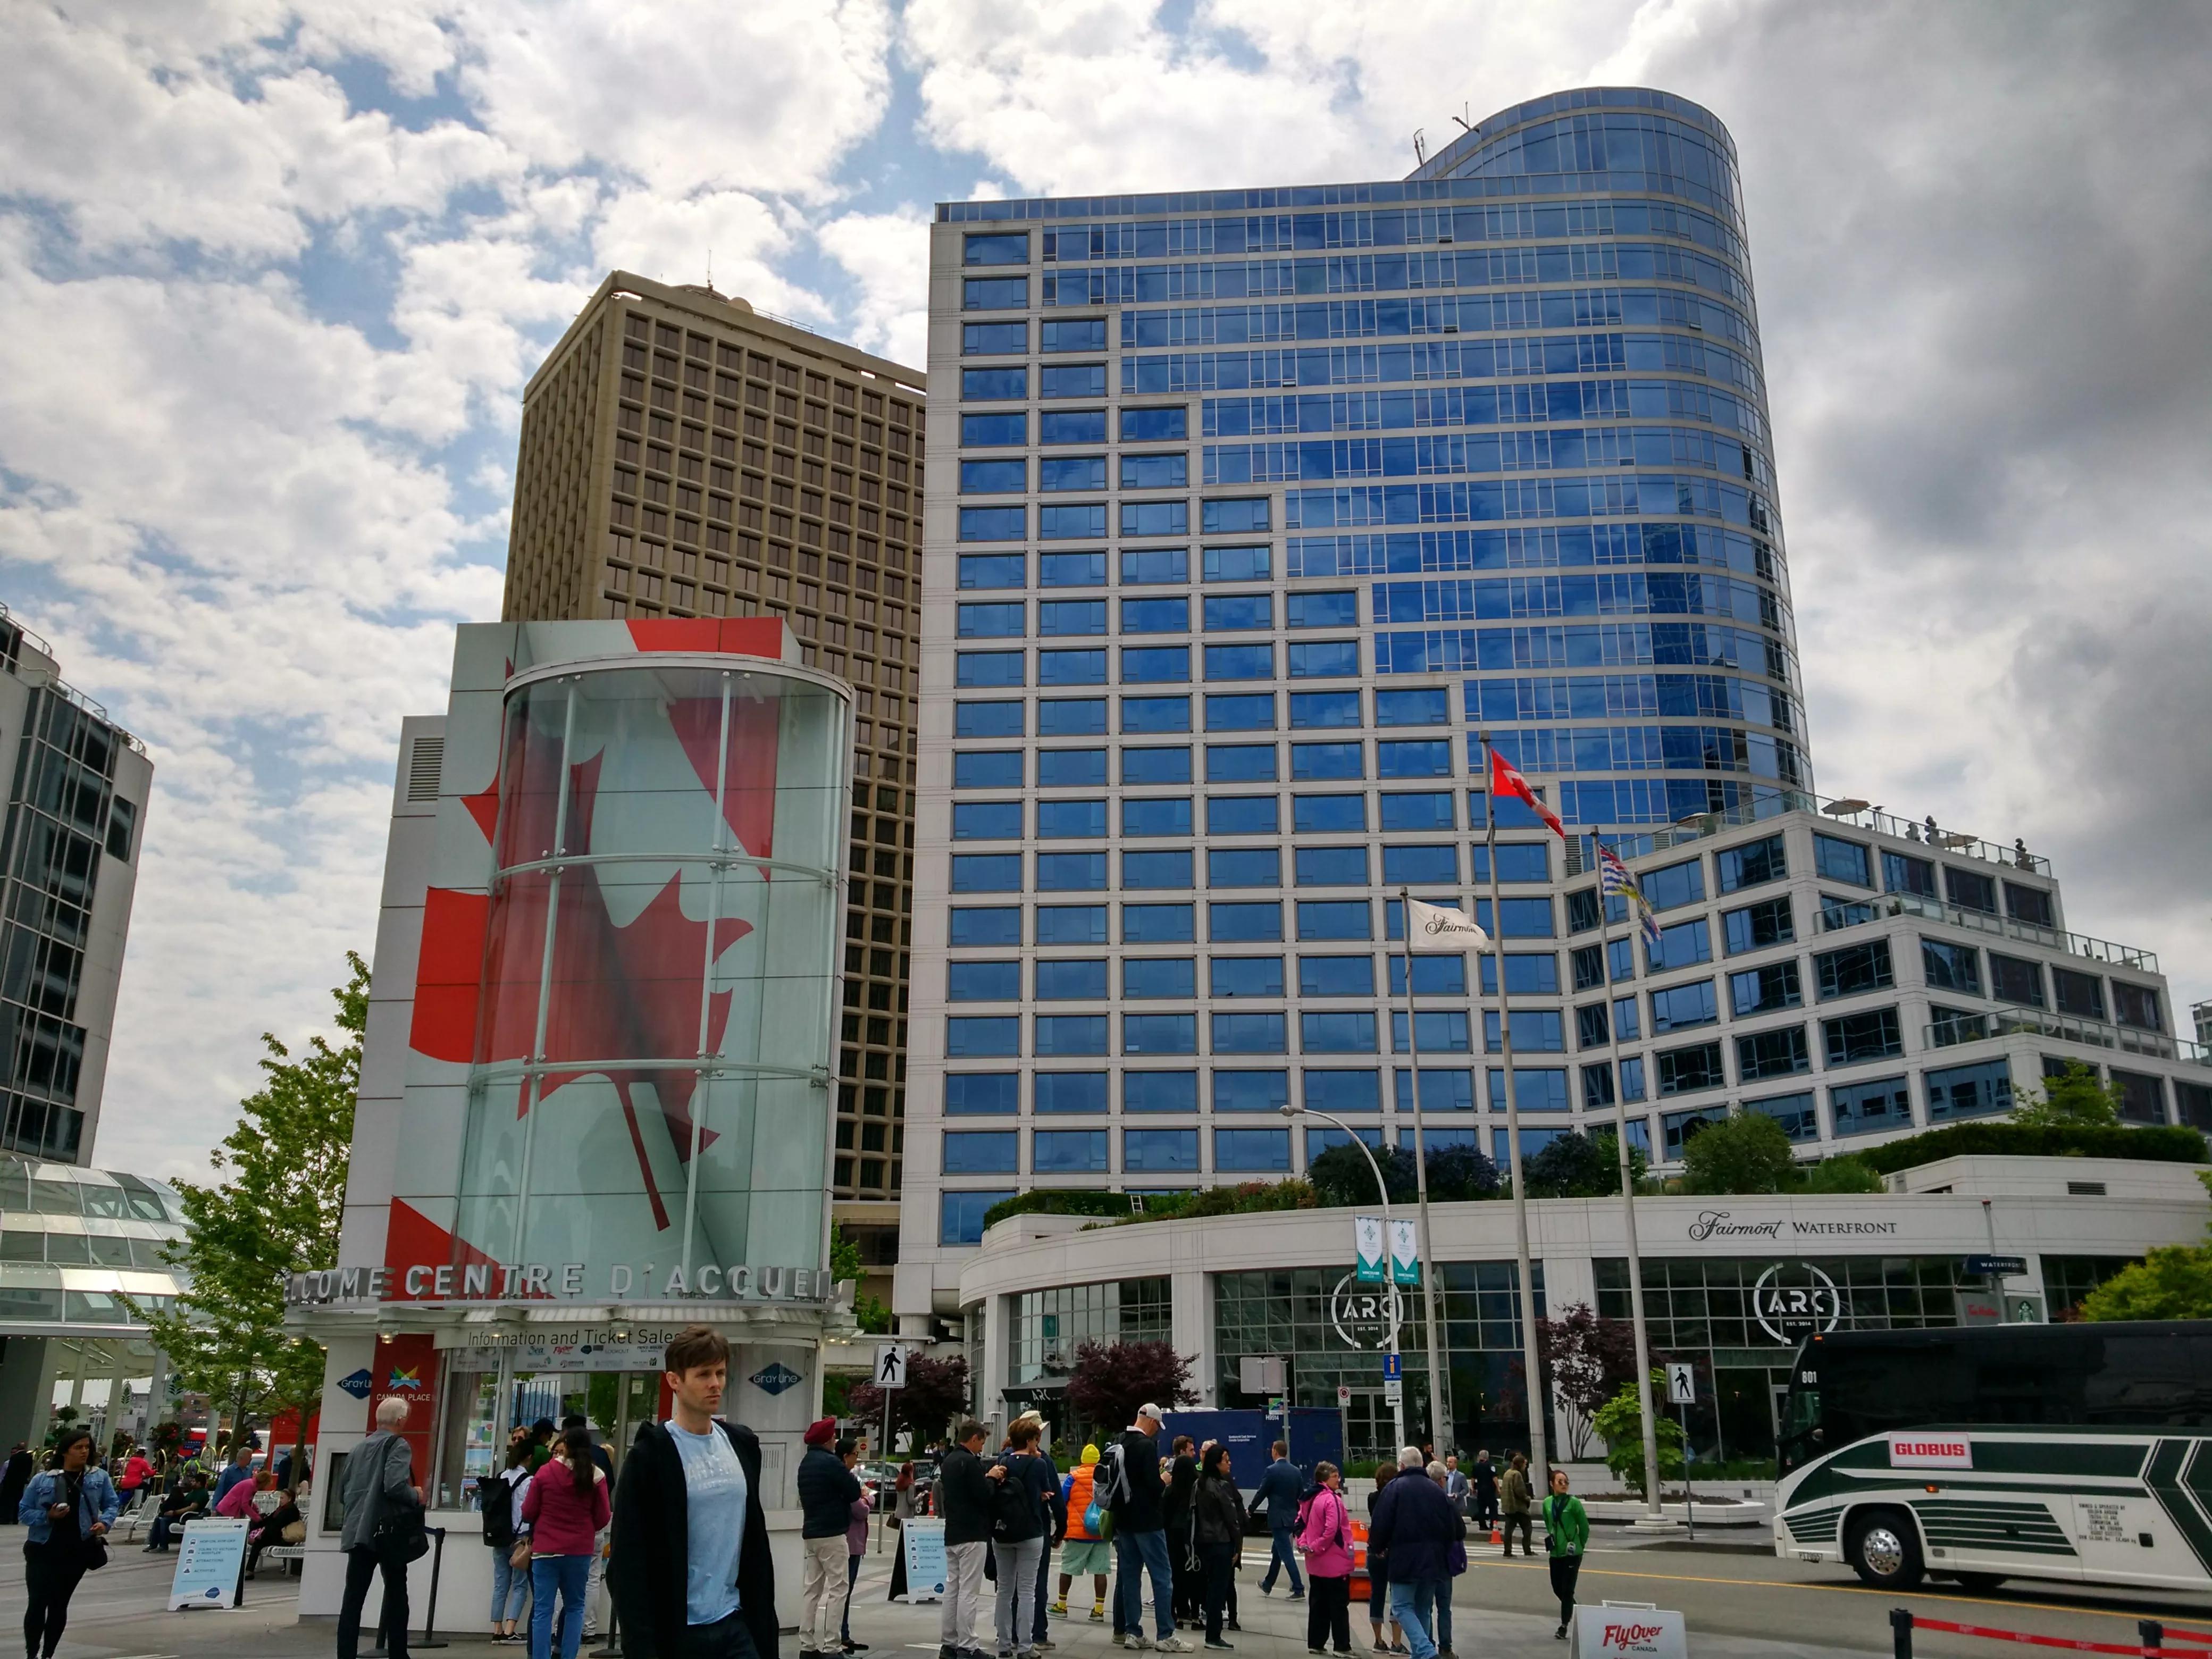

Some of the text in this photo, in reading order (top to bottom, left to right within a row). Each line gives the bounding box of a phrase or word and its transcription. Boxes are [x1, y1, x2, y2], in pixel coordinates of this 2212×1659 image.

[1689, 1211, 1897, 1241] Fairmont WATERFRONT
[405, 1263, 584, 1295] CENTRE
[1343, 1297, 1390, 1318] ARC
[1768, 1291, 1824, 1312] ARC
[468, 1330, 546, 1346] Information
[550, 1330, 579, 1345] and
[584, 1329, 633, 1344] Ticket
[341, 1379, 364, 1388] Gray
[753, 1373, 798, 1384] Gray Line
[1802, 1371, 1817, 1384] 801
[1895, 1443, 1965, 1456] GLOBUS
[1603, 1624, 1663, 1650] FlyOver
